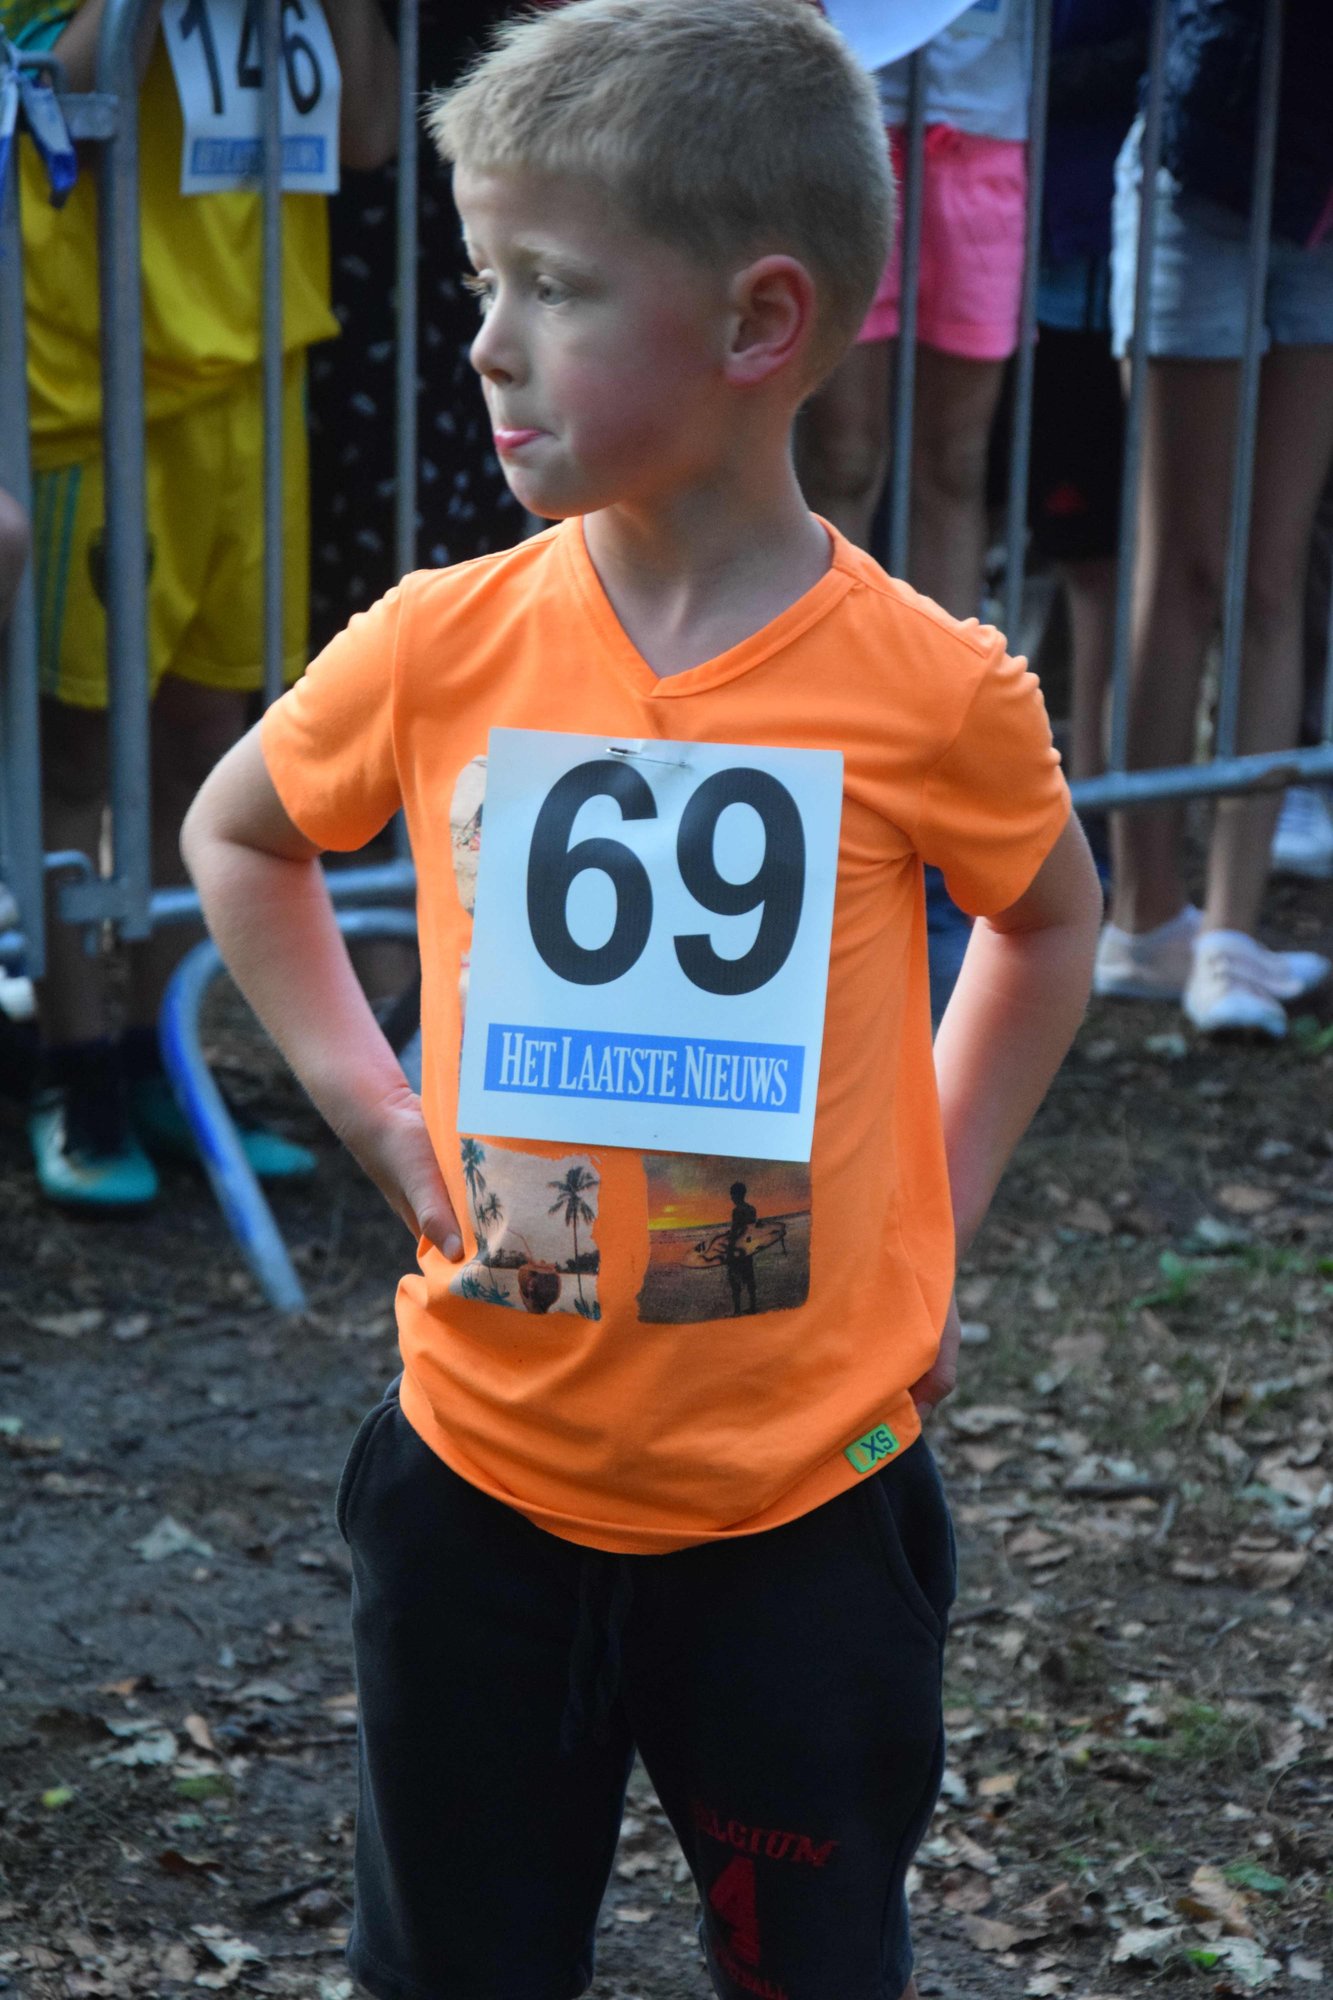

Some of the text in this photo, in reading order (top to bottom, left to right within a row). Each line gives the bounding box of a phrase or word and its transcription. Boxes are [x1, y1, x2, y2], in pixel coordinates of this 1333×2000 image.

[527, 759, 806, 995] 69
[499, 1032, 789, 1105] HET LAATSTE NIEUWS
[861, 1430, 893, 1460] XS
